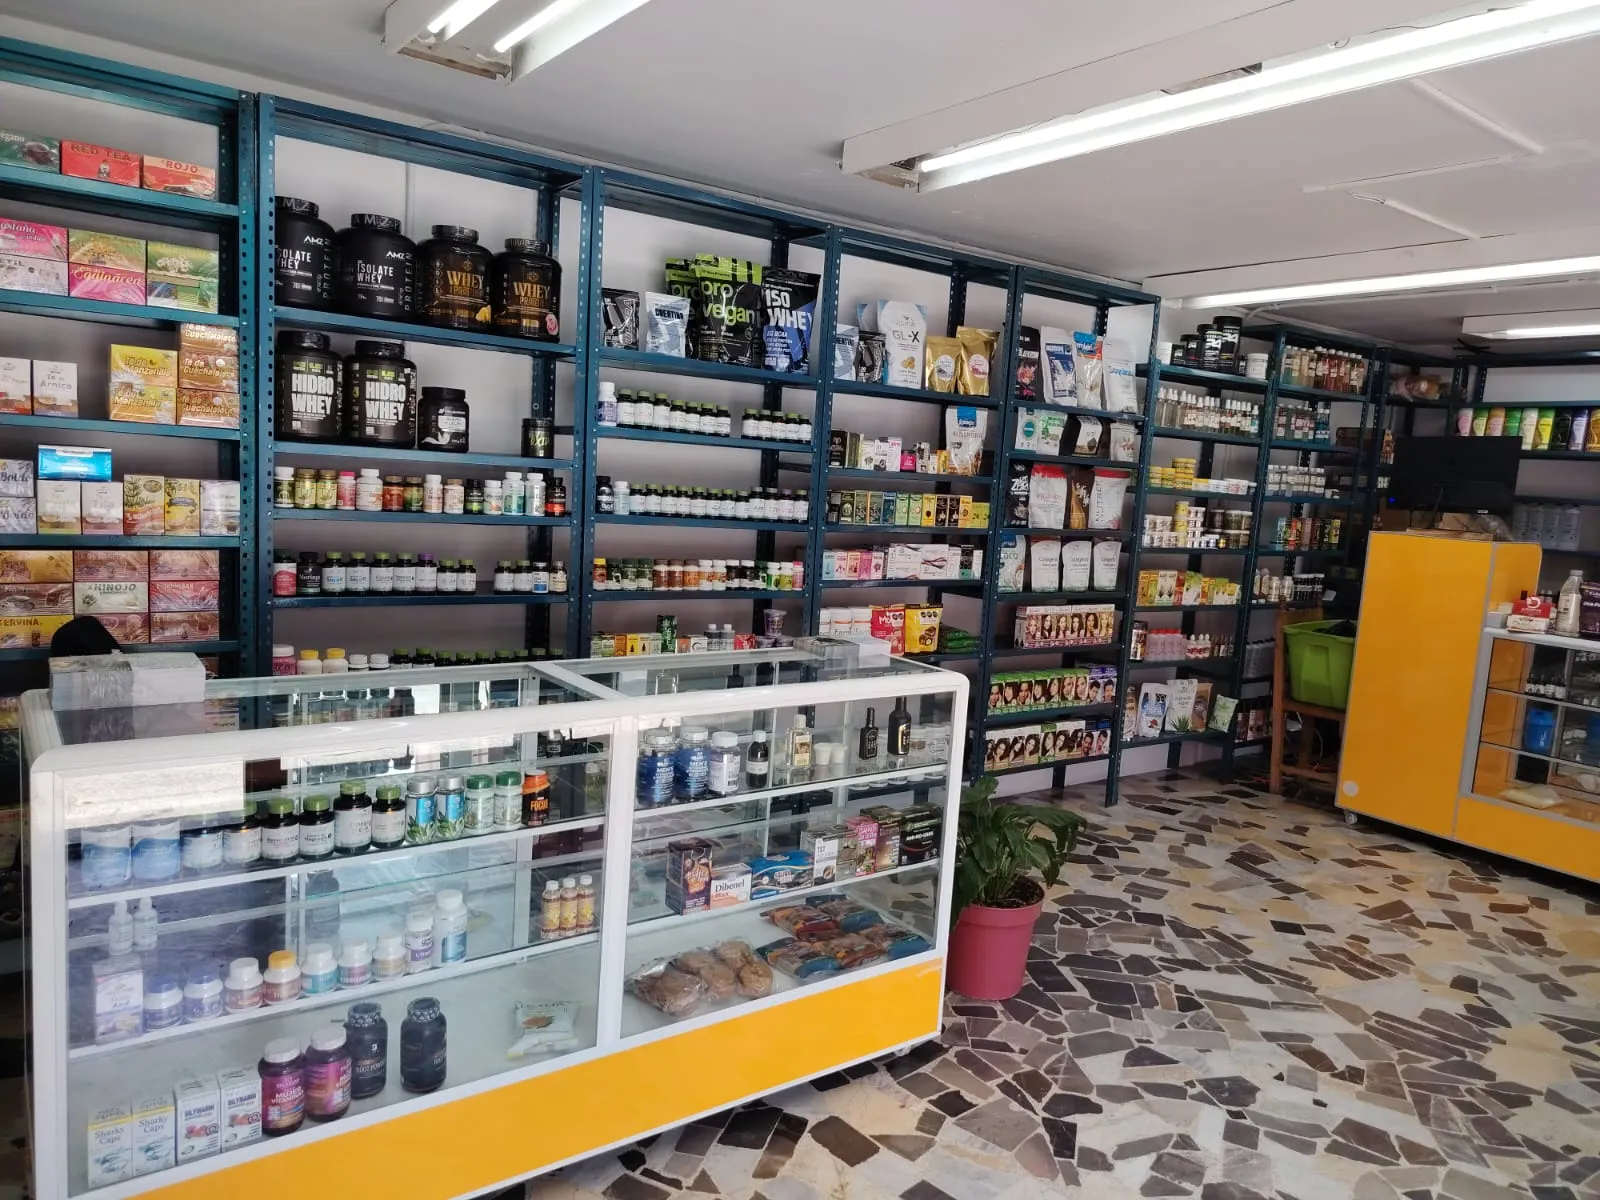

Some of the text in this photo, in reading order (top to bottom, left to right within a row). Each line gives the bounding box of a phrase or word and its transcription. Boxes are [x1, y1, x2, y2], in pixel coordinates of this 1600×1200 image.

[71, 143, 131, 162] RED TEA
[165, 159, 199, 174] ROJO
[357, 262, 394, 277] ISOLATE
[357, 272, 383, 284] WHEY
[446, 270, 484, 289] WHEY
[512, 281, 551, 300] WHEY
[701, 280, 734, 299] pro
[765, 288, 791, 308] ISO
[703, 303, 755, 327] vegan
[291, 372, 334, 396] HIDRO
[365, 380, 407, 402] HIDRO
[291, 392, 333, 415] WHEY
[365, 400, 404, 421] WHEY
